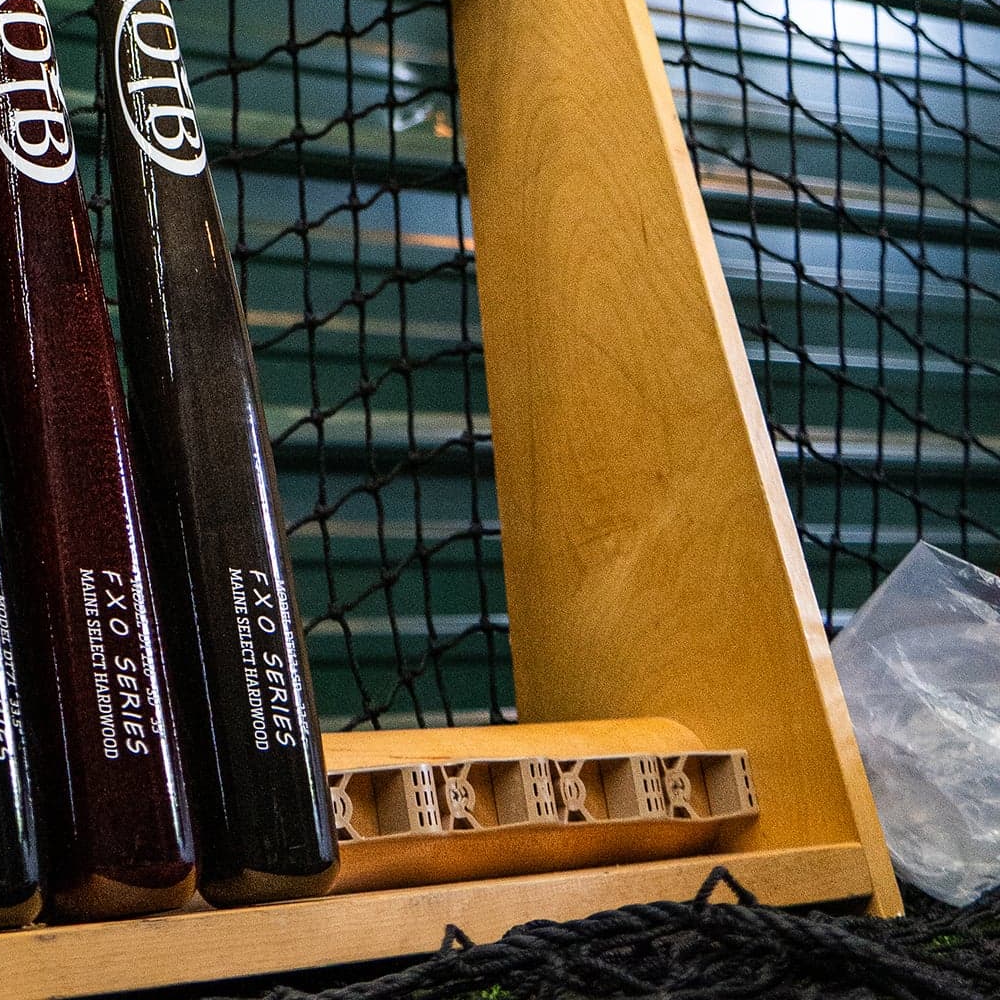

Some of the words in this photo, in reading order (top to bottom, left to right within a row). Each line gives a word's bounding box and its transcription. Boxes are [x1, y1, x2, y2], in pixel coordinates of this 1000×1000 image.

[79, 568, 99, 617] MAINE
[228, 567, 248, 615] MAINE
[87, 618, 107, 670] SELECT
[236, 616, 257, 666] SELECT
[93, 671, 119, 760] HARDWOOD
[114, 655, 149, 756] SERIES
[244, 666, 270, 751] HARDWOOD
[263, 651, 296, 748] SERIES
